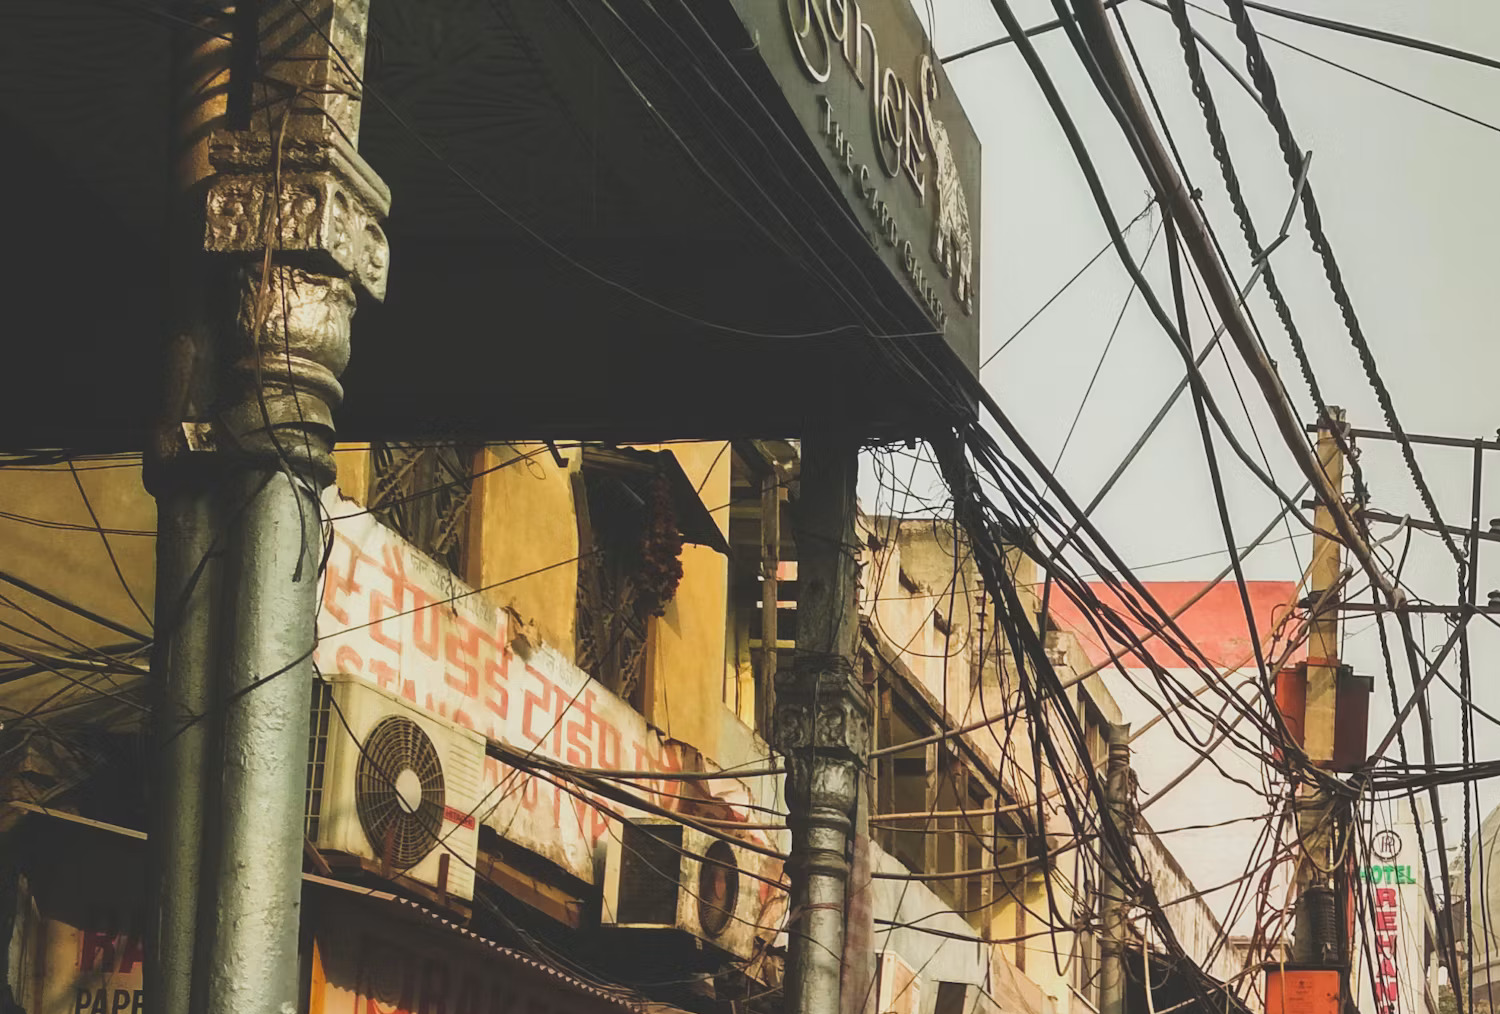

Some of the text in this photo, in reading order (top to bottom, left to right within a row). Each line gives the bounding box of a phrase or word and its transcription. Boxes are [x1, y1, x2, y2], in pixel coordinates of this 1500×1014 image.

[824, 97, 948, 333] THE CARD GALLERY
[1360, 865, 1416, 885] HOTEL
